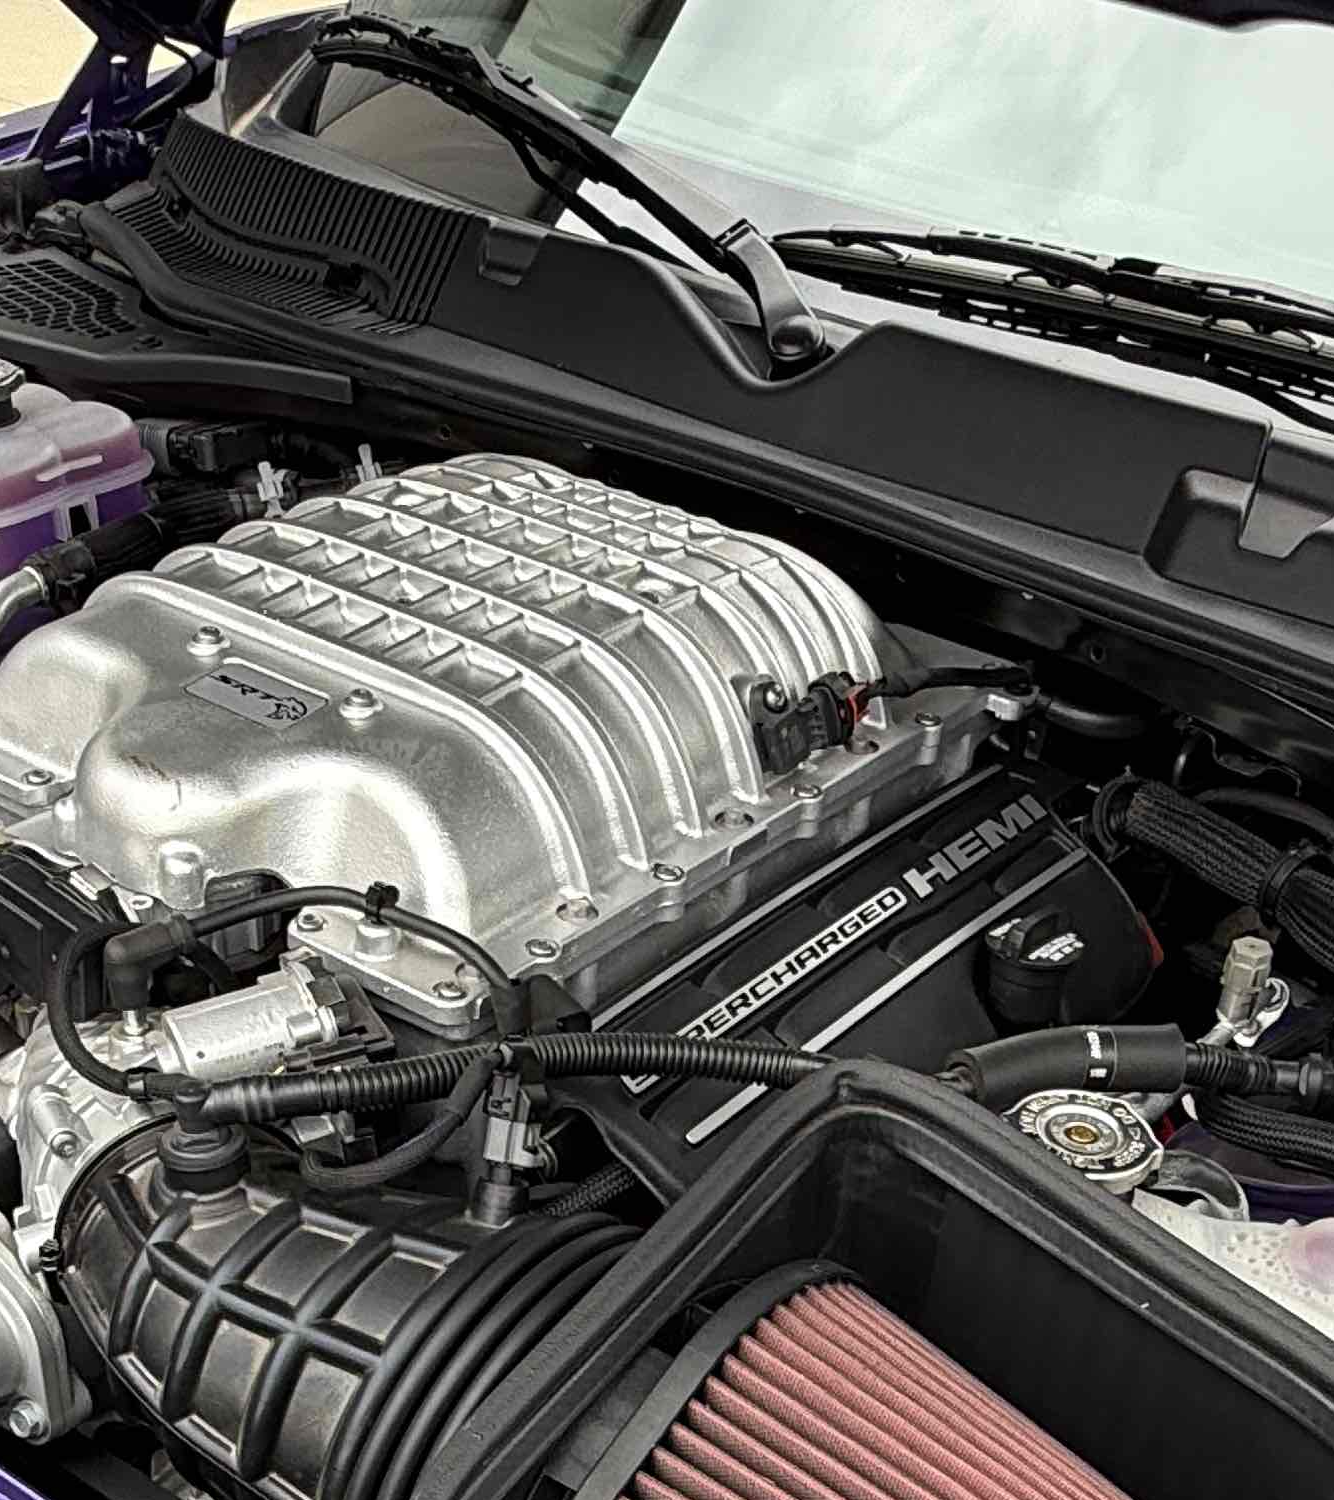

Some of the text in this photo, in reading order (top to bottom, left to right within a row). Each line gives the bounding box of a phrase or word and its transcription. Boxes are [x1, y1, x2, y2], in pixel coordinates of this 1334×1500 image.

[214, 674, 281, 700] SRT
[902, 794, 1050, 899] HEMI
[622, 885, 905, 1090] PERCHARGED
